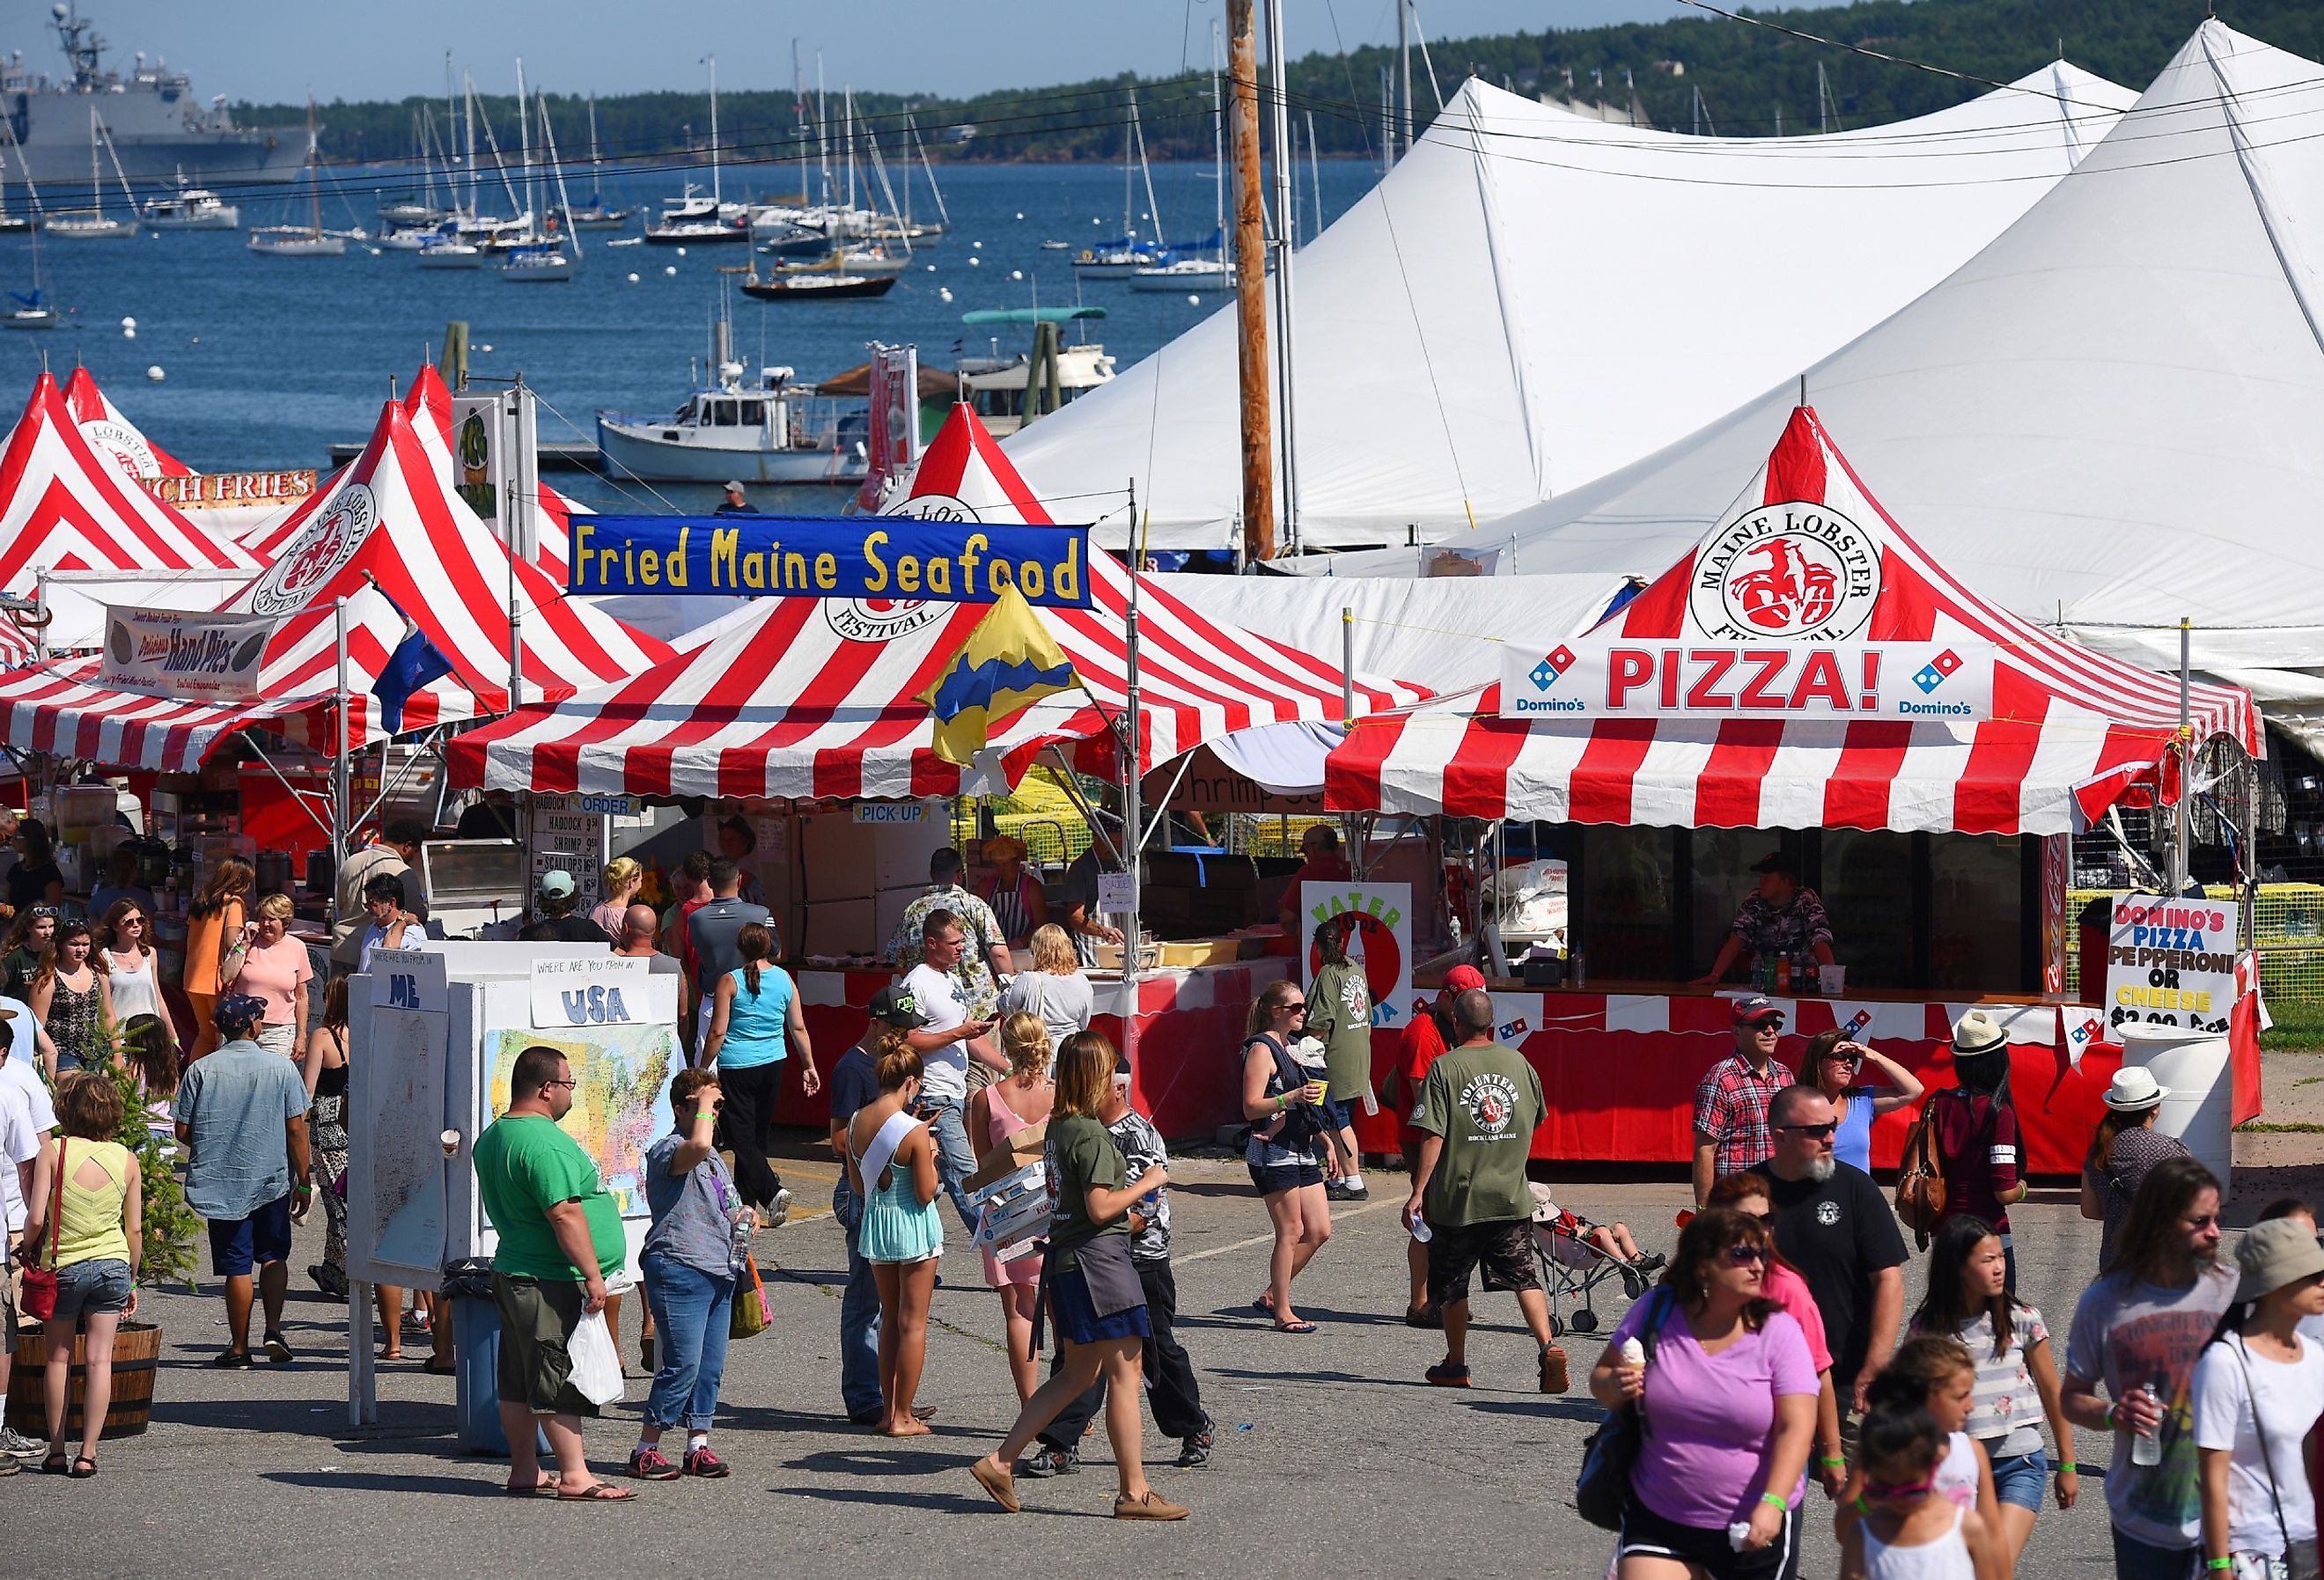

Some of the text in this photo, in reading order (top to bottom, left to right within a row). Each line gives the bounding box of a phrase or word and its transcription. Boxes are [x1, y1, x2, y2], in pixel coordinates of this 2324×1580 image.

[215, 473, 310, 501] FRIES
[288, 492, 369, 565] MAINE LOBSTER
[576, 525, 1081, 601] Fried Maine Seafood
[1701, 512, 1872, 599] MAINE LOBSTER
[834, 608, 934, 638] FESTIVAL
[138, 628, 239, 674] Delicious Hand Pies
[1607, 647, 1883, 712] PIZZA!
[1516, 696, 1585, 713] Domino's
[1899, 701, 1973, 717] Domino's
[1163, 757, 1272, 812] Shrimp
[536, 796, 565, 810] HADDOCK
[582, 797, 629, 813] ORDER
[863, 805, 922, 820] PICK UP
[549, 816, 582, 830] HADDOCK
[554, 835, 582, 851] SHRIMP
[544, 856, 582, 871] SCALLOPS
[1311, 893, 1401, 930] WATER
[2114, 904, 2225, 932] DOMINO'S
[2133, 926, 2205, 952] PIZZA
[537, 962, 564, 974] WHERE
[570, 960, 584, 972] ARE
[588, 960, 603, 972] YOU
[606, 960, 624, 970] FROM
[2109, 945, 2235, 974] PEPPERONI
[389, 974, 420, 1009] ME
[2148, 968, 2181, 990] OR
[562, 985, 631, 1025] USA
[2116, 986, 2212, 1013] CHEESE
[1459, 1073, 1519, 1106] VOLUNTEER
